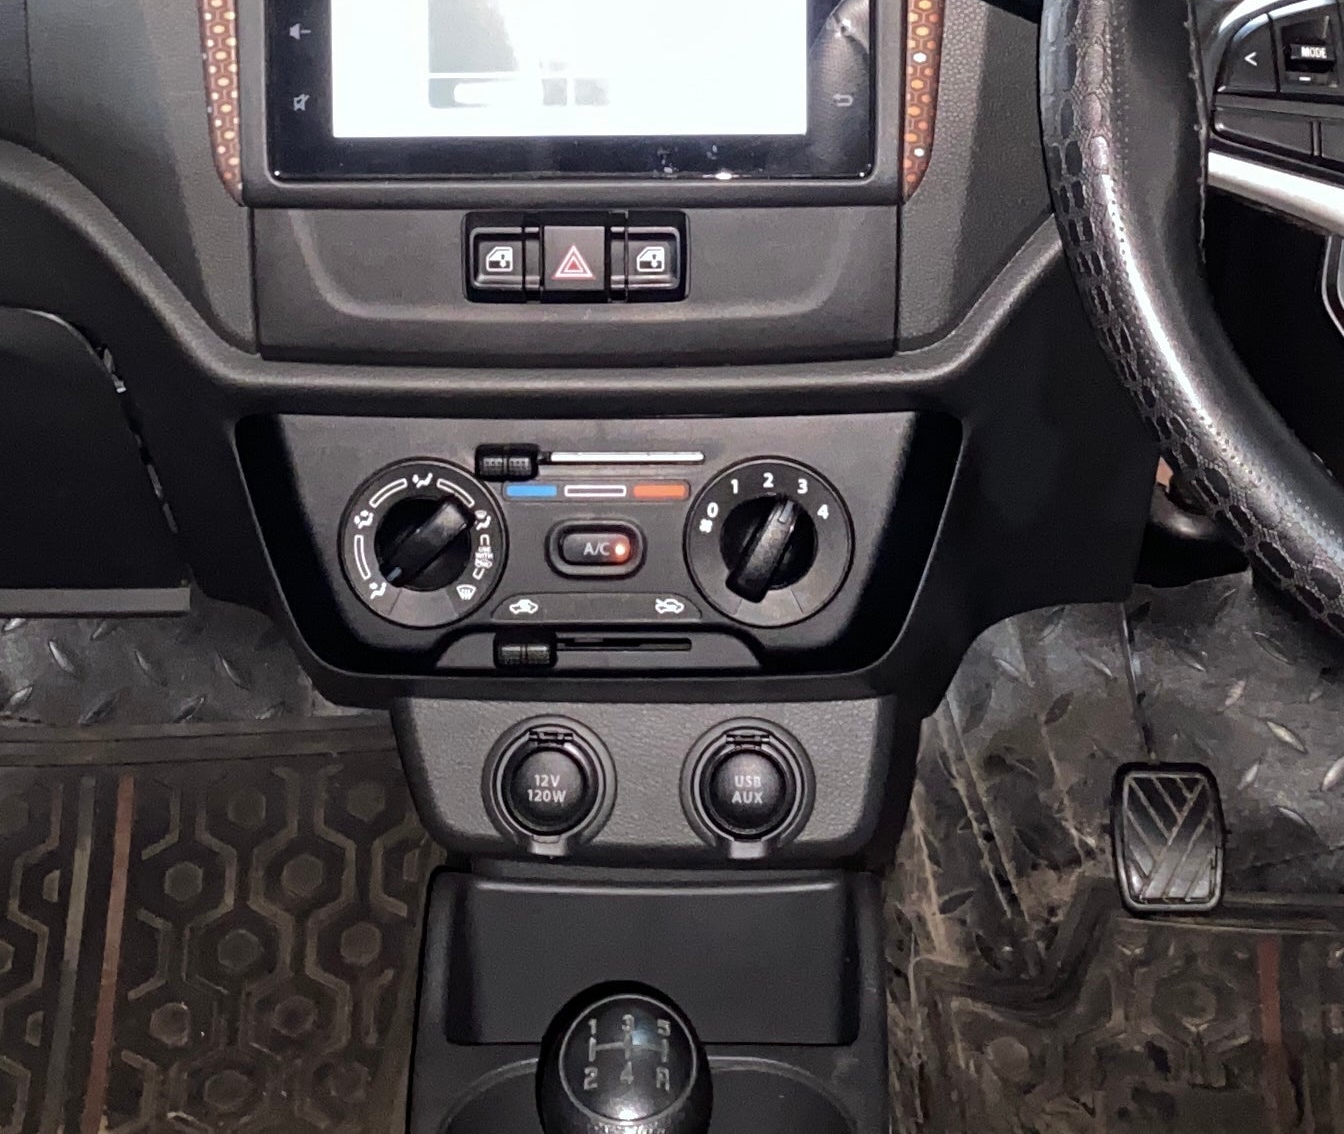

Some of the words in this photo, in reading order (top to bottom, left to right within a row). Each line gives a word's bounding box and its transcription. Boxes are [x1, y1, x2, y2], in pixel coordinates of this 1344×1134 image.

[1301, 46, 1327, 58] MODE
[730, 478, 739, 494] 1
[763, 472, 774, 488] 2
[797, 478, 808, 494] 3
[707, 502, 719, 518] 0
[817, 504, 829, 520] 4
[583, 541, 610, 556] A/C
[534, 774, 561, 787] 12V
[734, 775, 762, 788] USB
[527, 789, 567, 803] 120W
[731, 790, 763, 804] AUX
[588, 1018, 597, 1035] 1
[657, 1018, 671, 1037] 5
[583, 1067, 598, 1090] 2
[619, 1061, 634, 1085] 4
